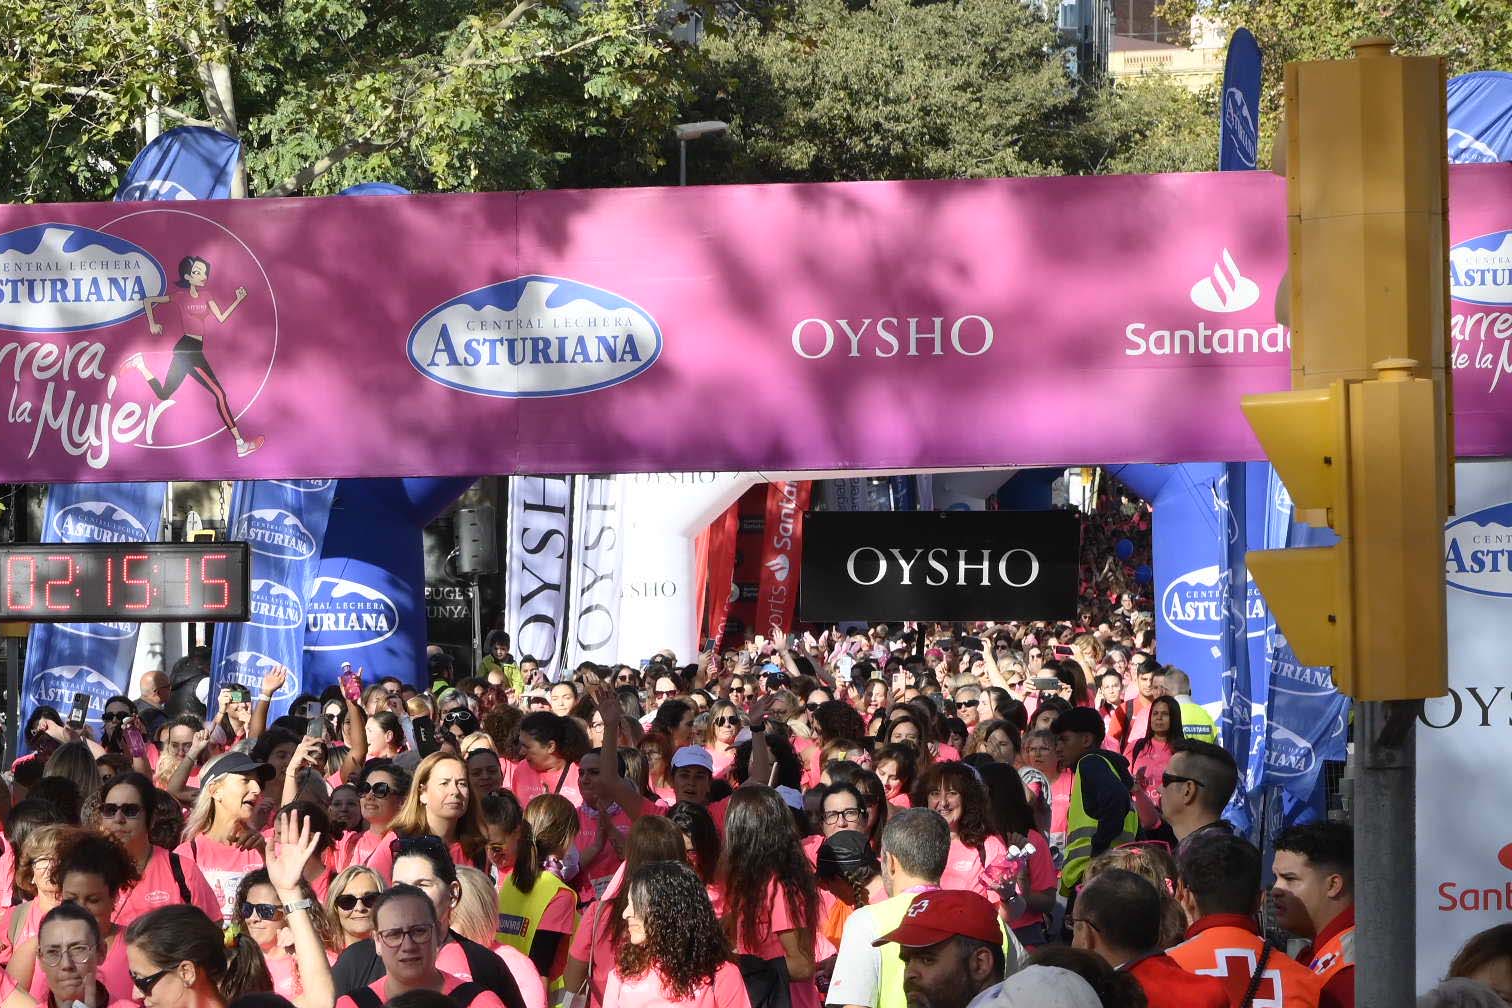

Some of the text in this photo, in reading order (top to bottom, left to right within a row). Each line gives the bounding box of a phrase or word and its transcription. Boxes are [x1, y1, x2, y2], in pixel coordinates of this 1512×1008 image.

[70, 260, 142, 270] LECHERA
[466, 317, 633, 332] CENTRAL LECHERA
[791, 314, 994, 360] OYSHO
[1125, 321, 1292, 355] Santand
[427, 323, 643, 367] ASTURIANA
[1475, 341, 1492, 369] la
[8, 385, 33, 423] la
[26, 375, 176, 469] Mujer
[238, 521, 307, 554] ASTURIANA
[6, 555, 229, 610] 02:15:15
[846, 547, 1040, 588] OYSHO
